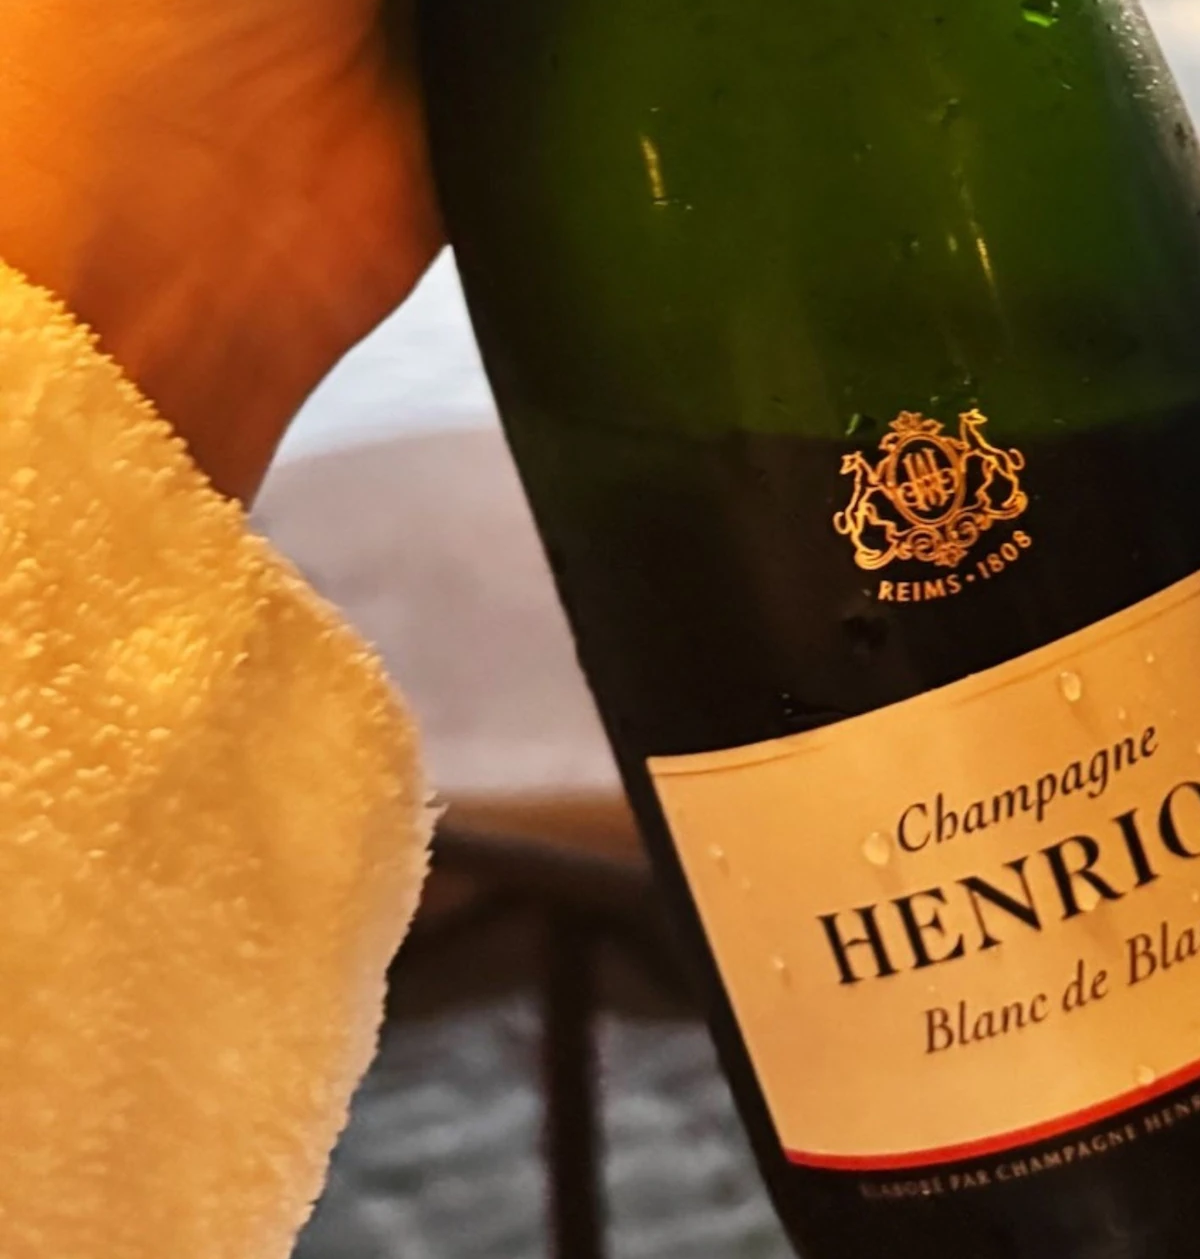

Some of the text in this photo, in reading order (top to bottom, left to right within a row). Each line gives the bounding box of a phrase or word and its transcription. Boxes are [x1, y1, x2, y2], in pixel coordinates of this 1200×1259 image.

[878, 573, 962, 602] REIMS
[896, 725, 1160, 853] Champagne
[924, 990, 1049, 1055] Blanc
[1062, 958, 1109, 1014] de
